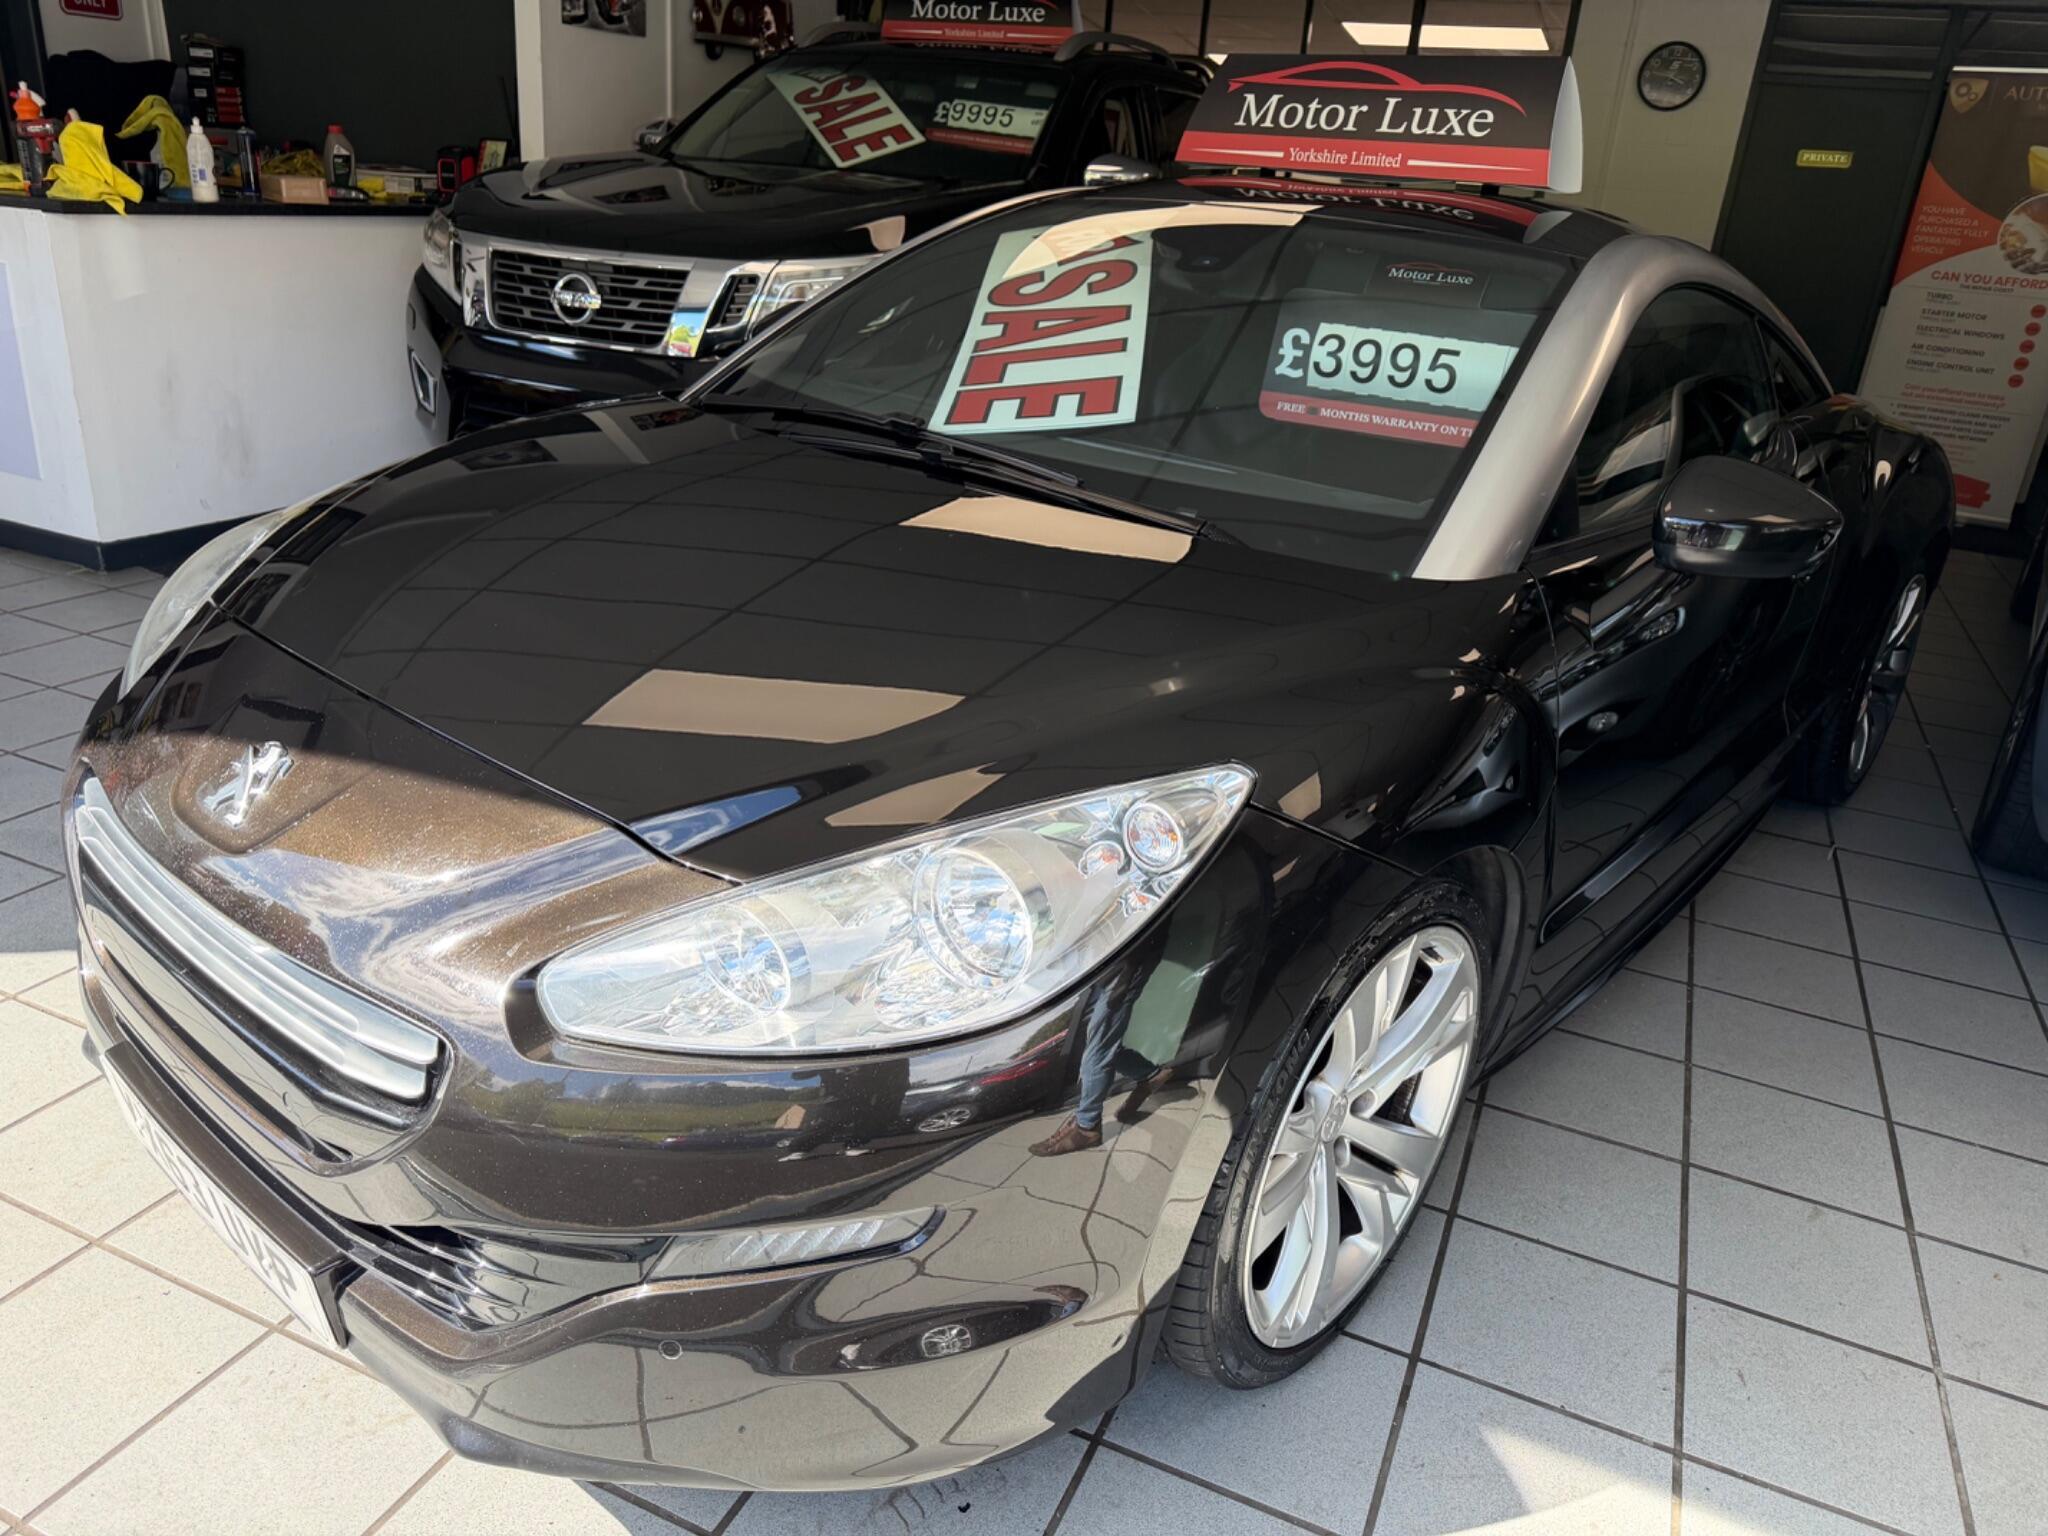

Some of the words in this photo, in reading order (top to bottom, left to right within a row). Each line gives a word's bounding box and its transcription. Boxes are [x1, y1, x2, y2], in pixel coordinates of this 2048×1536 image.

[911, 0, 982, 20] Motor
[987, 1, 1045, 23] Luxe
[2006, 85, 2048, 100] AUT
[793, 75, 915, 163] SALE
[933, 101, 1015, 128] £9995
[1234, 93, 1371, 132] Motor
[1375, 97, 1495, 138] Luxe
[1289, 147, 1348, 165] Yorkshire
[1350, 151, 1402, 168] Limited
[1802, 152, 1849, 163] PRIVATE
[1941, 207, 1967, 215] HAVE
[1918, 215, 1971, 227] PURCHASED
[1915, 225, 1962, 236] FANTASTIC
[1964, 230, 1991, 239] FULLY
[1913, 235, 1961, 246] OPERATING
[1911, 245, 1944, 255] VEHICLE
[1388, 267, 1434, 281] Motor
[1436, 271, 1475, 285] Luxe
[1931, 270, 1961, 282] CAN
[1963, 272, 1993, 285] YOU
[1993, 276, 2048, 290] AFFORD
[1926, 291, 1953, 301] TURBO
[1921, 307, 1956, 318] STARTER
[1957, 312, 1988, 321] MOTOR
[1916, 324, 1961, 336] ELECTRICAL
[1964, 330, 2005, 340] WINDOWS
[944, 259, 1139, 425] SALE
[1926, 345, 1986, 357] CONDITIONING
[1274, 328, 1462, 394] £3995
[1906, 358, 1935, 368] ENGINE
[1936, 362, 1974, 373] CONTROL
[1975, 367, 1996, 375] UNIT
[1276, 400, 1306, 414] FREE
[1320, 408, 1370, 423] MONTHS
[1371, 414, 1439, 433] WARRANTY
[1440, 425, 1458, 436] ON
